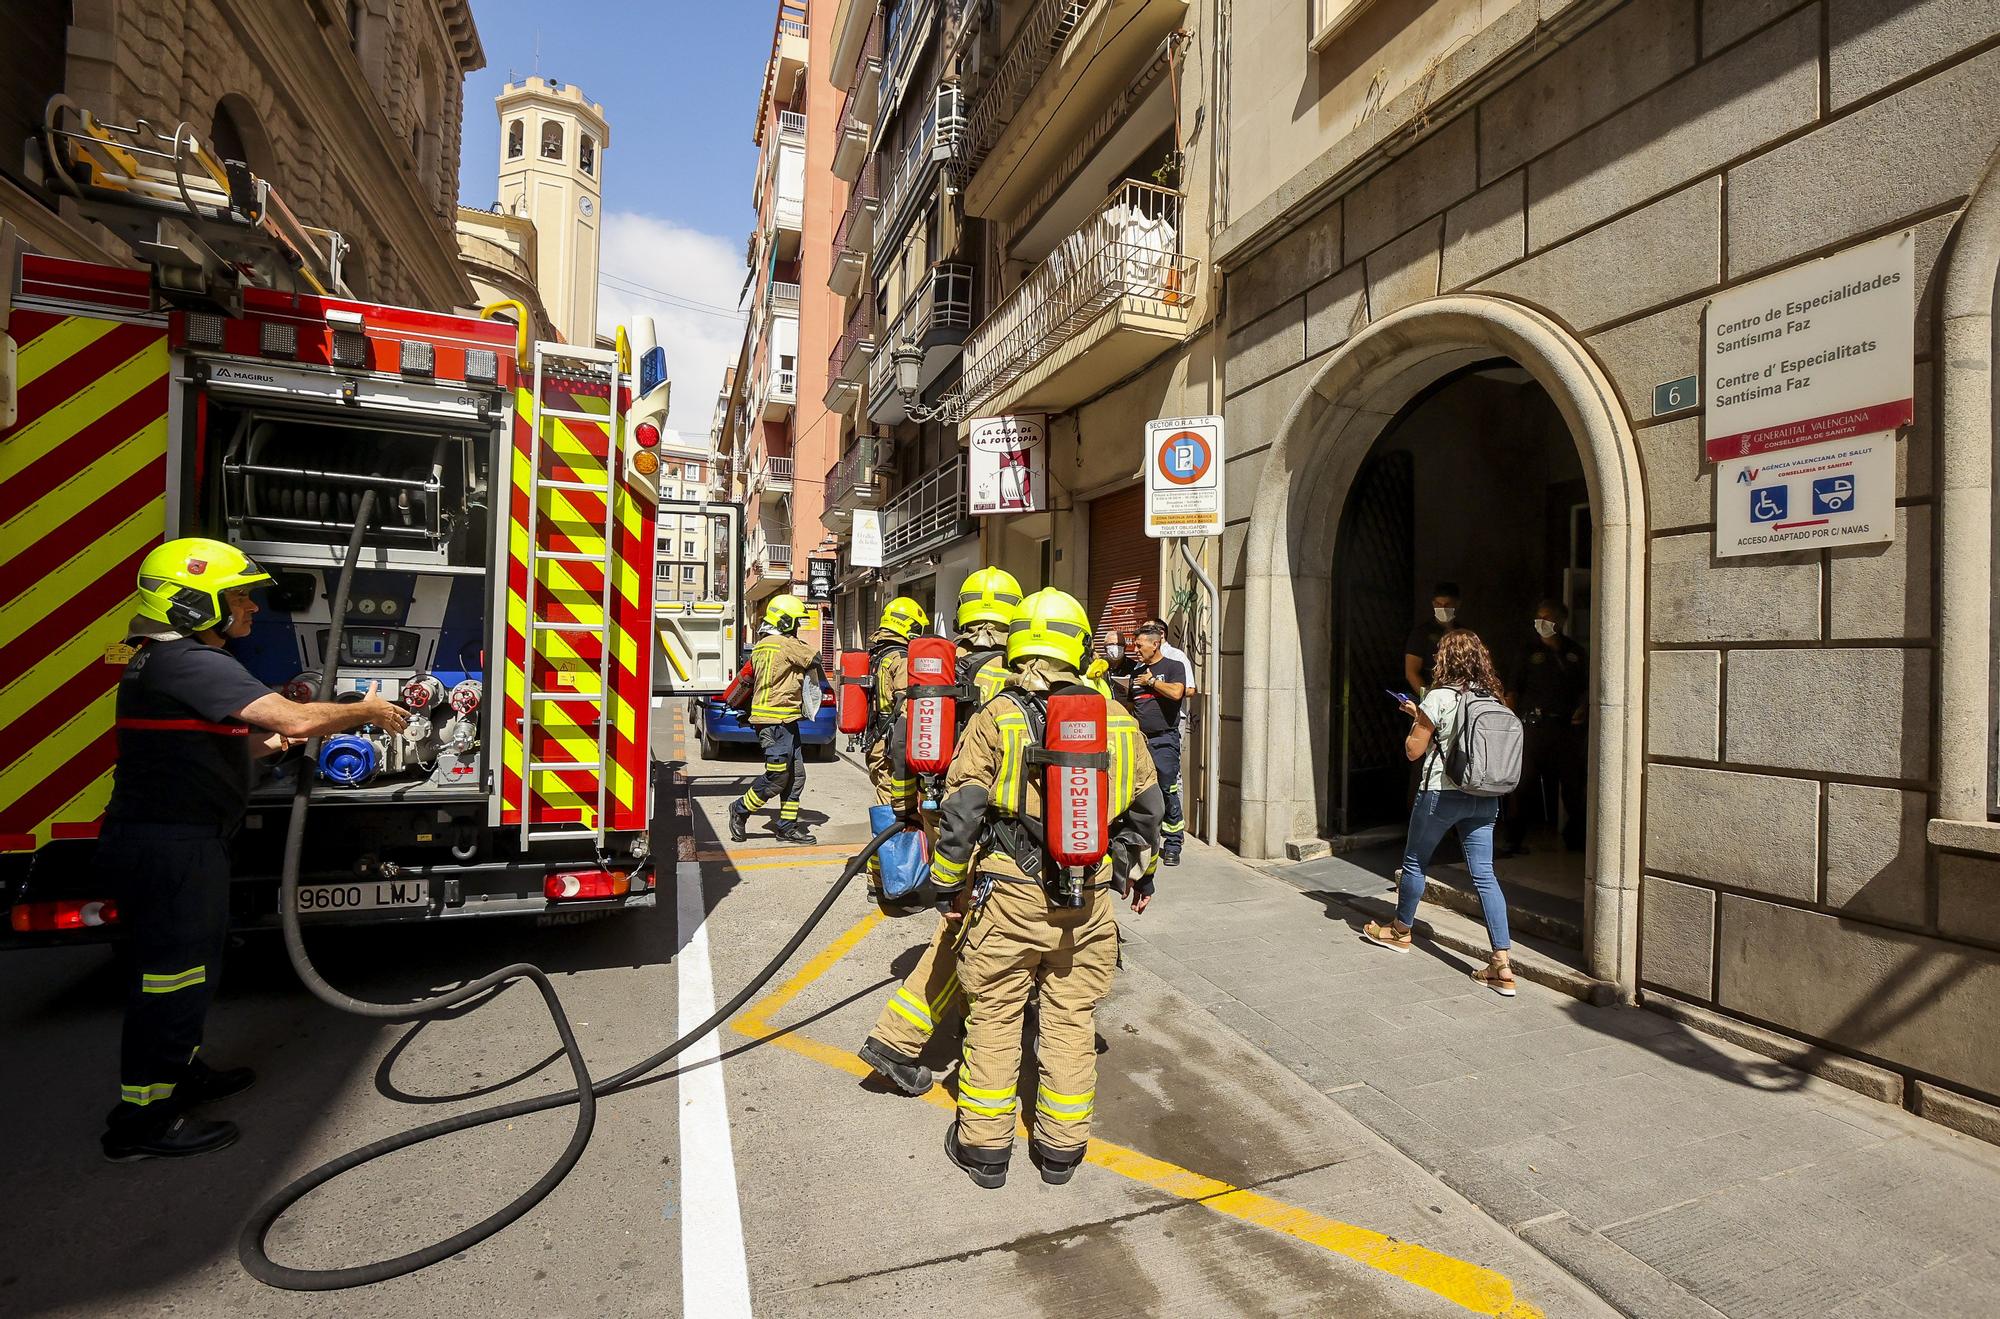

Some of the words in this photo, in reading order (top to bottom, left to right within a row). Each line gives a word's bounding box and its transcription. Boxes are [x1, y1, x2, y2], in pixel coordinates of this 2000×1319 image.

[1716, 315, 1761, 337] Centro
[1765, 308, 1782, 323] de
[1786, 271, 1902, 316] Especialidades
[1786, 318, 1811, 335] Faz
[1716, 370, 1760, 391] Centre
[1780, 339, 1878, 374] Especialitats
[233, 372, 274, 383] MAGIRUS
[1668, 386, 1681, 407] 6
[1715, 383, 1783, 409] Santísima
[1786, 376, 1811, 392] Faz
[995, 427, 1017, 435] CASA
[1021, 426, 1032, 434] DE
[1149, 421, 1173, 430] SECTOR
[1753, 425, 1806, 443] GENERALITAT
[1810, 411, 1869, 432] VALENCIANA
[990, 435, 1038, 445] FOTOCOPIA
[1764, 435, 1812, 449] CONSELLERIA
[1813, 432, 1824, 440] DE
[1825, 425, 1857, 438] SANITAT
[1791, 454, 1836, 467] VALENCIANA
[1837, 451, 1848, 459] DE
[1849, 447, 1873, 458] SALUT
[1777, 467, 1816, 478] CONSELLERIA
[1817, 464, 1827, 472] DE
[1827, 460, 1853, 470] SANITAT
[1737, 535, 1768, 546] ACCESO
[1768, 529, 1811, 543] ADAPTADO
[1812, 528, 1829, 538] POR
[1830, 526, 1840, 536] C/
[1841, 523, 1870, 535] NAVAS
[811, 561, 832, 571] TALLER
[918, 699, 935, 758] OMBEROS
[1070, 766, 1089, 851] BOMBEROS
[299, 886, 361, 910] 9600
[375, 883, 421, 906] LMJ
